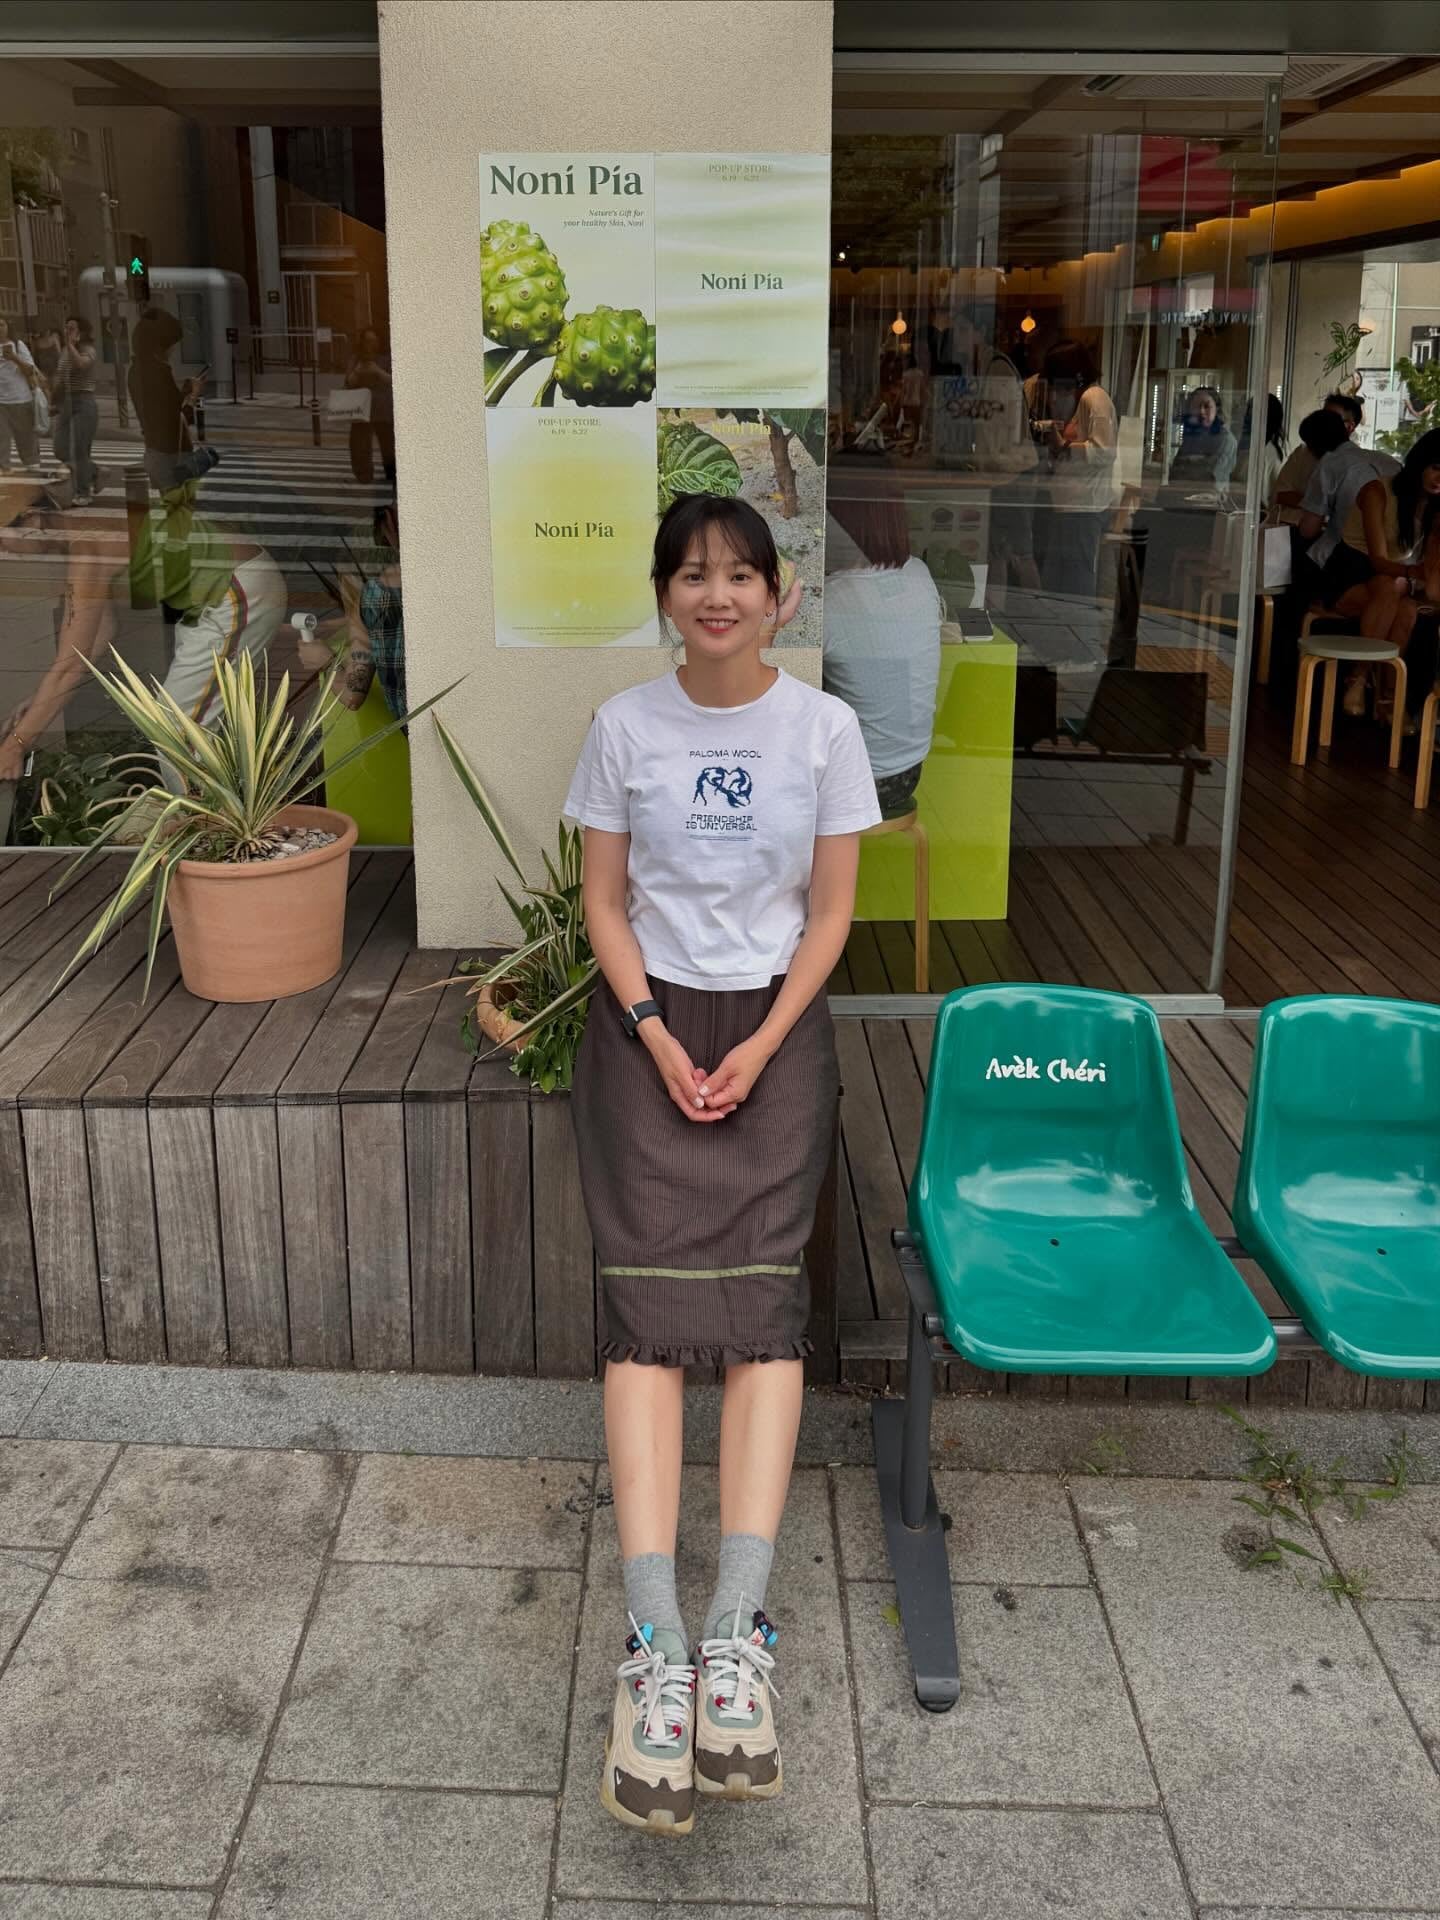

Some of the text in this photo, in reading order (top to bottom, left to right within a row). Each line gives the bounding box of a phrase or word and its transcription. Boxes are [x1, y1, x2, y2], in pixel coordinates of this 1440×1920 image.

[588, 208, 644, 218] Nature's Gift for
[562, 220, 580, 229] your
[581, 219, 607, 229] healthy
[537, 418, 602, 426] POP-UP STORE
[689, 749, 762, 758] PALOMA WOOL
[690, 814, 753, 823] FRIENDSHIP
[685, 821, 757, 831] IS UNIVERSAL
[985, 1055, 1107, 1083] Avèk Chéri
